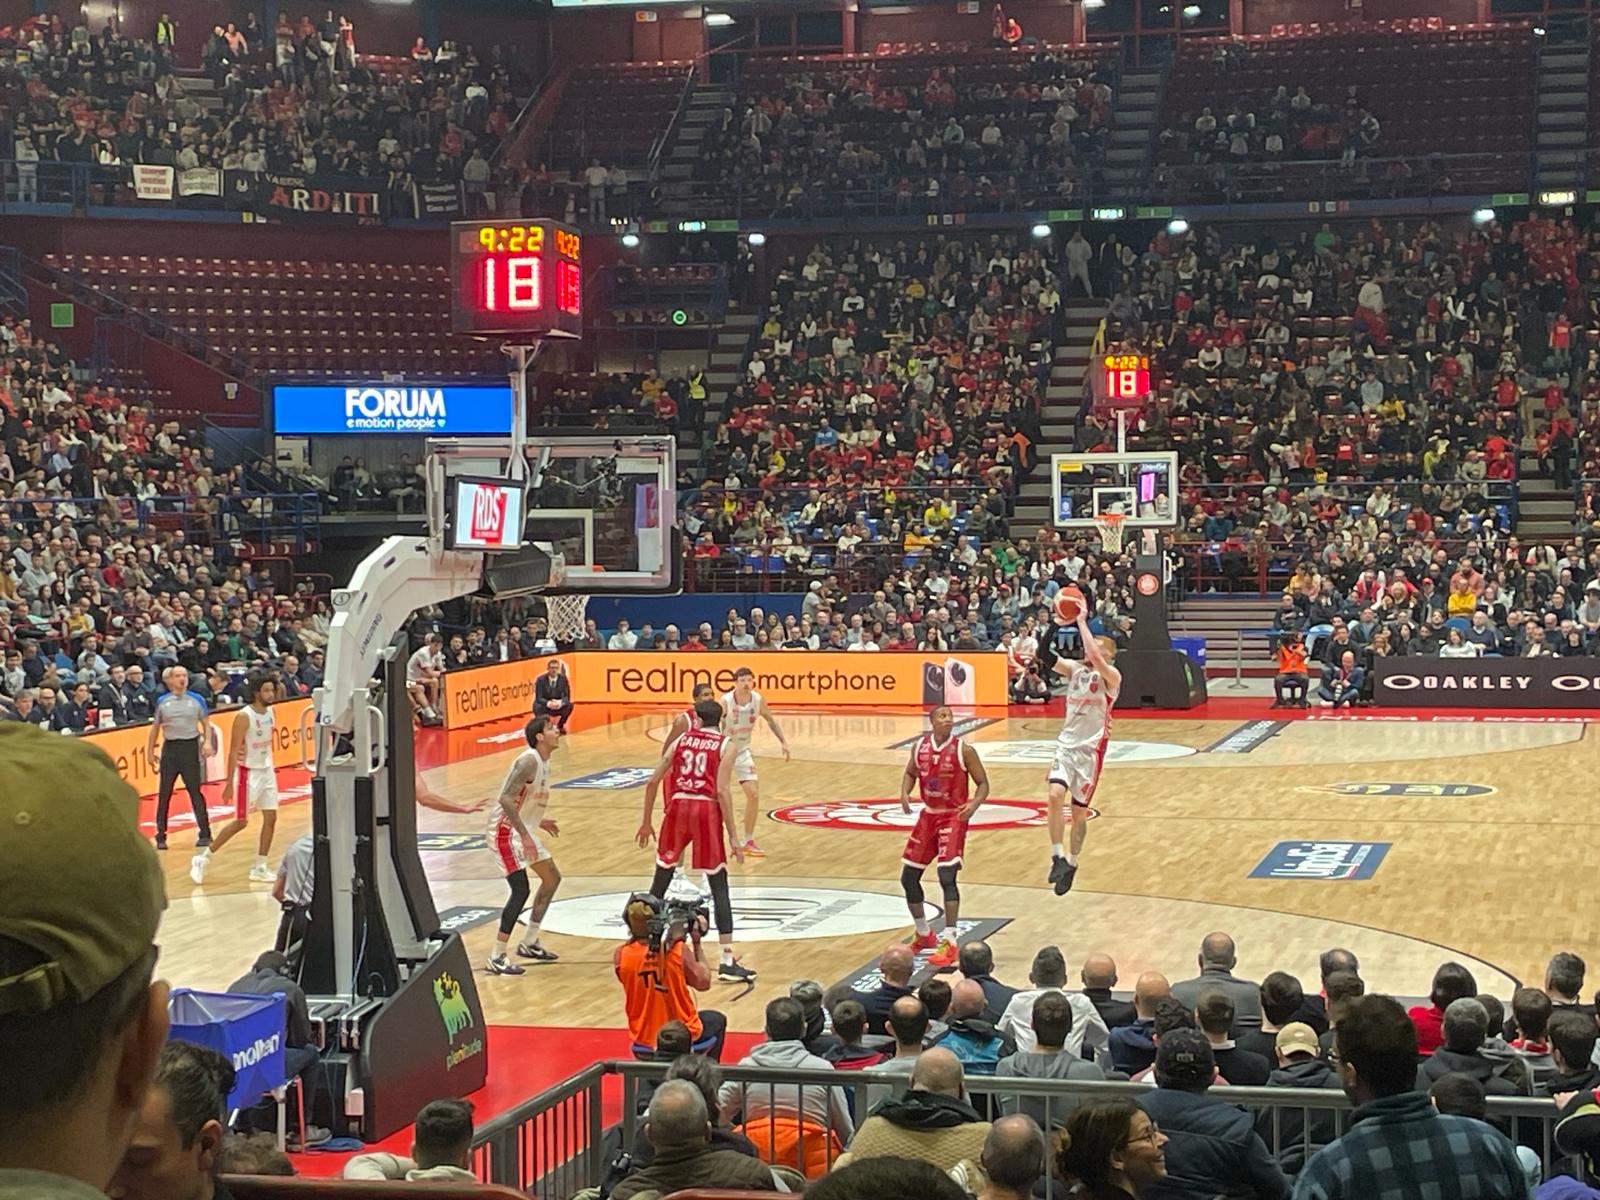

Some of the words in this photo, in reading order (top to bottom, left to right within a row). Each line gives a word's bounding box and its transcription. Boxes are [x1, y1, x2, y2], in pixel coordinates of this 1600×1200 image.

[479, 226, 544, 252] 9:22
[485, 257, 541, 310] 18
[1108, 370, 1137, 397] 18
[344, 388, 446, 417] FORUM
[396, 417, 436, 430] people
[474, 487, 501, 531] RDS
[606, 662, 737, 693] realme
[1423, 676, 1532, 689] OAKLEY
[455, 681, 500, 714] realme
[501, 679, 534, 702] smartph
[679, 735, 720, 751] CARUSO
[680, 750, 708, 777] 30
[233, 1033, 280, 1072] molten
